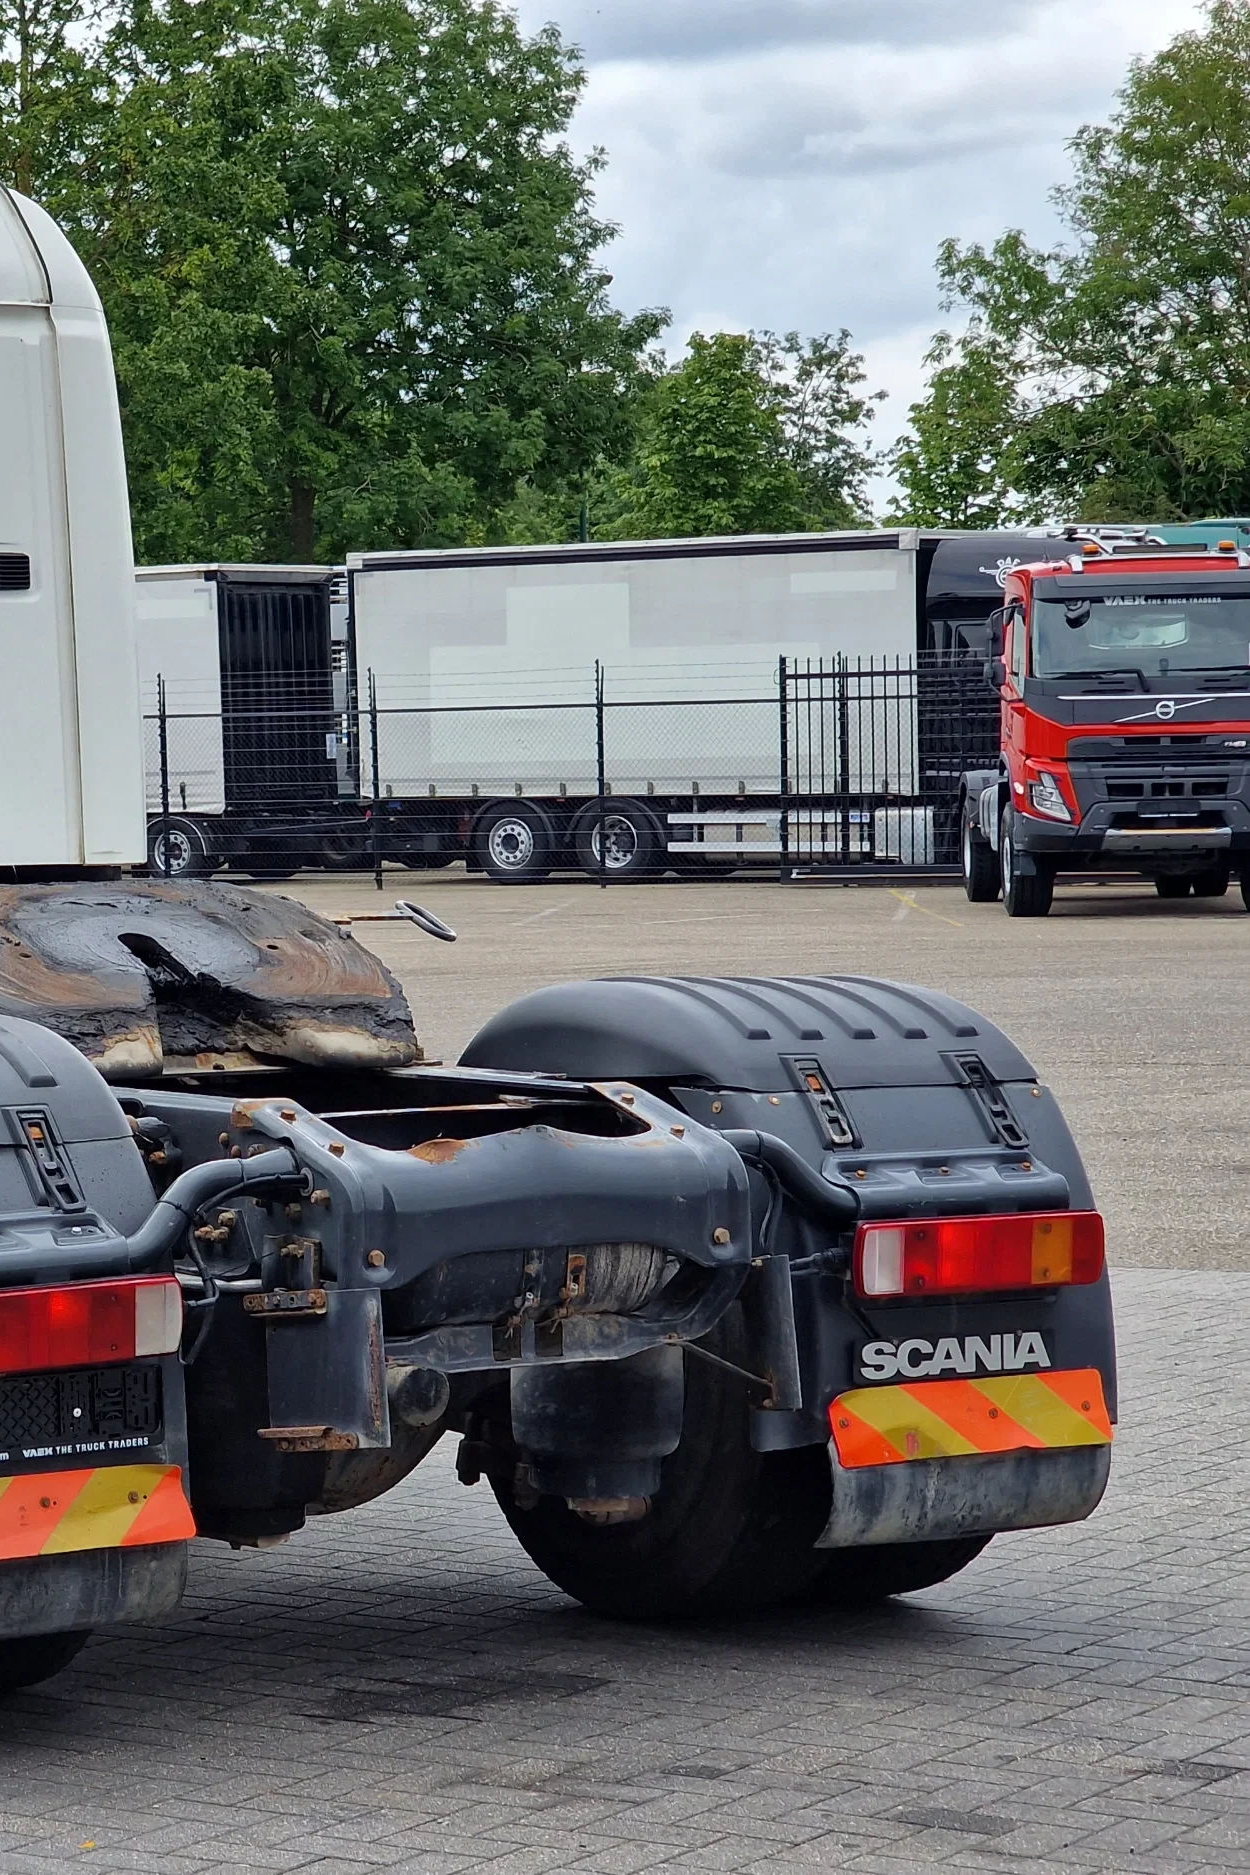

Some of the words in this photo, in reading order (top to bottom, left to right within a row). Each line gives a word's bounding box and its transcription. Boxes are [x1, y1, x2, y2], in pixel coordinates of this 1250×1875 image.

[996, 556, 1021, 568] DAF
[1103, 596, 1147, 606] VAEX
[860, 1331, 1051, 1380] SCANIA
[22, 1446, 53, 1458] VAEX
[55, 1444, 73, 1455] THE
[75, 1441, 106, 1453] TRUCK
[107, 1437, 149, 1450] TRADERS
